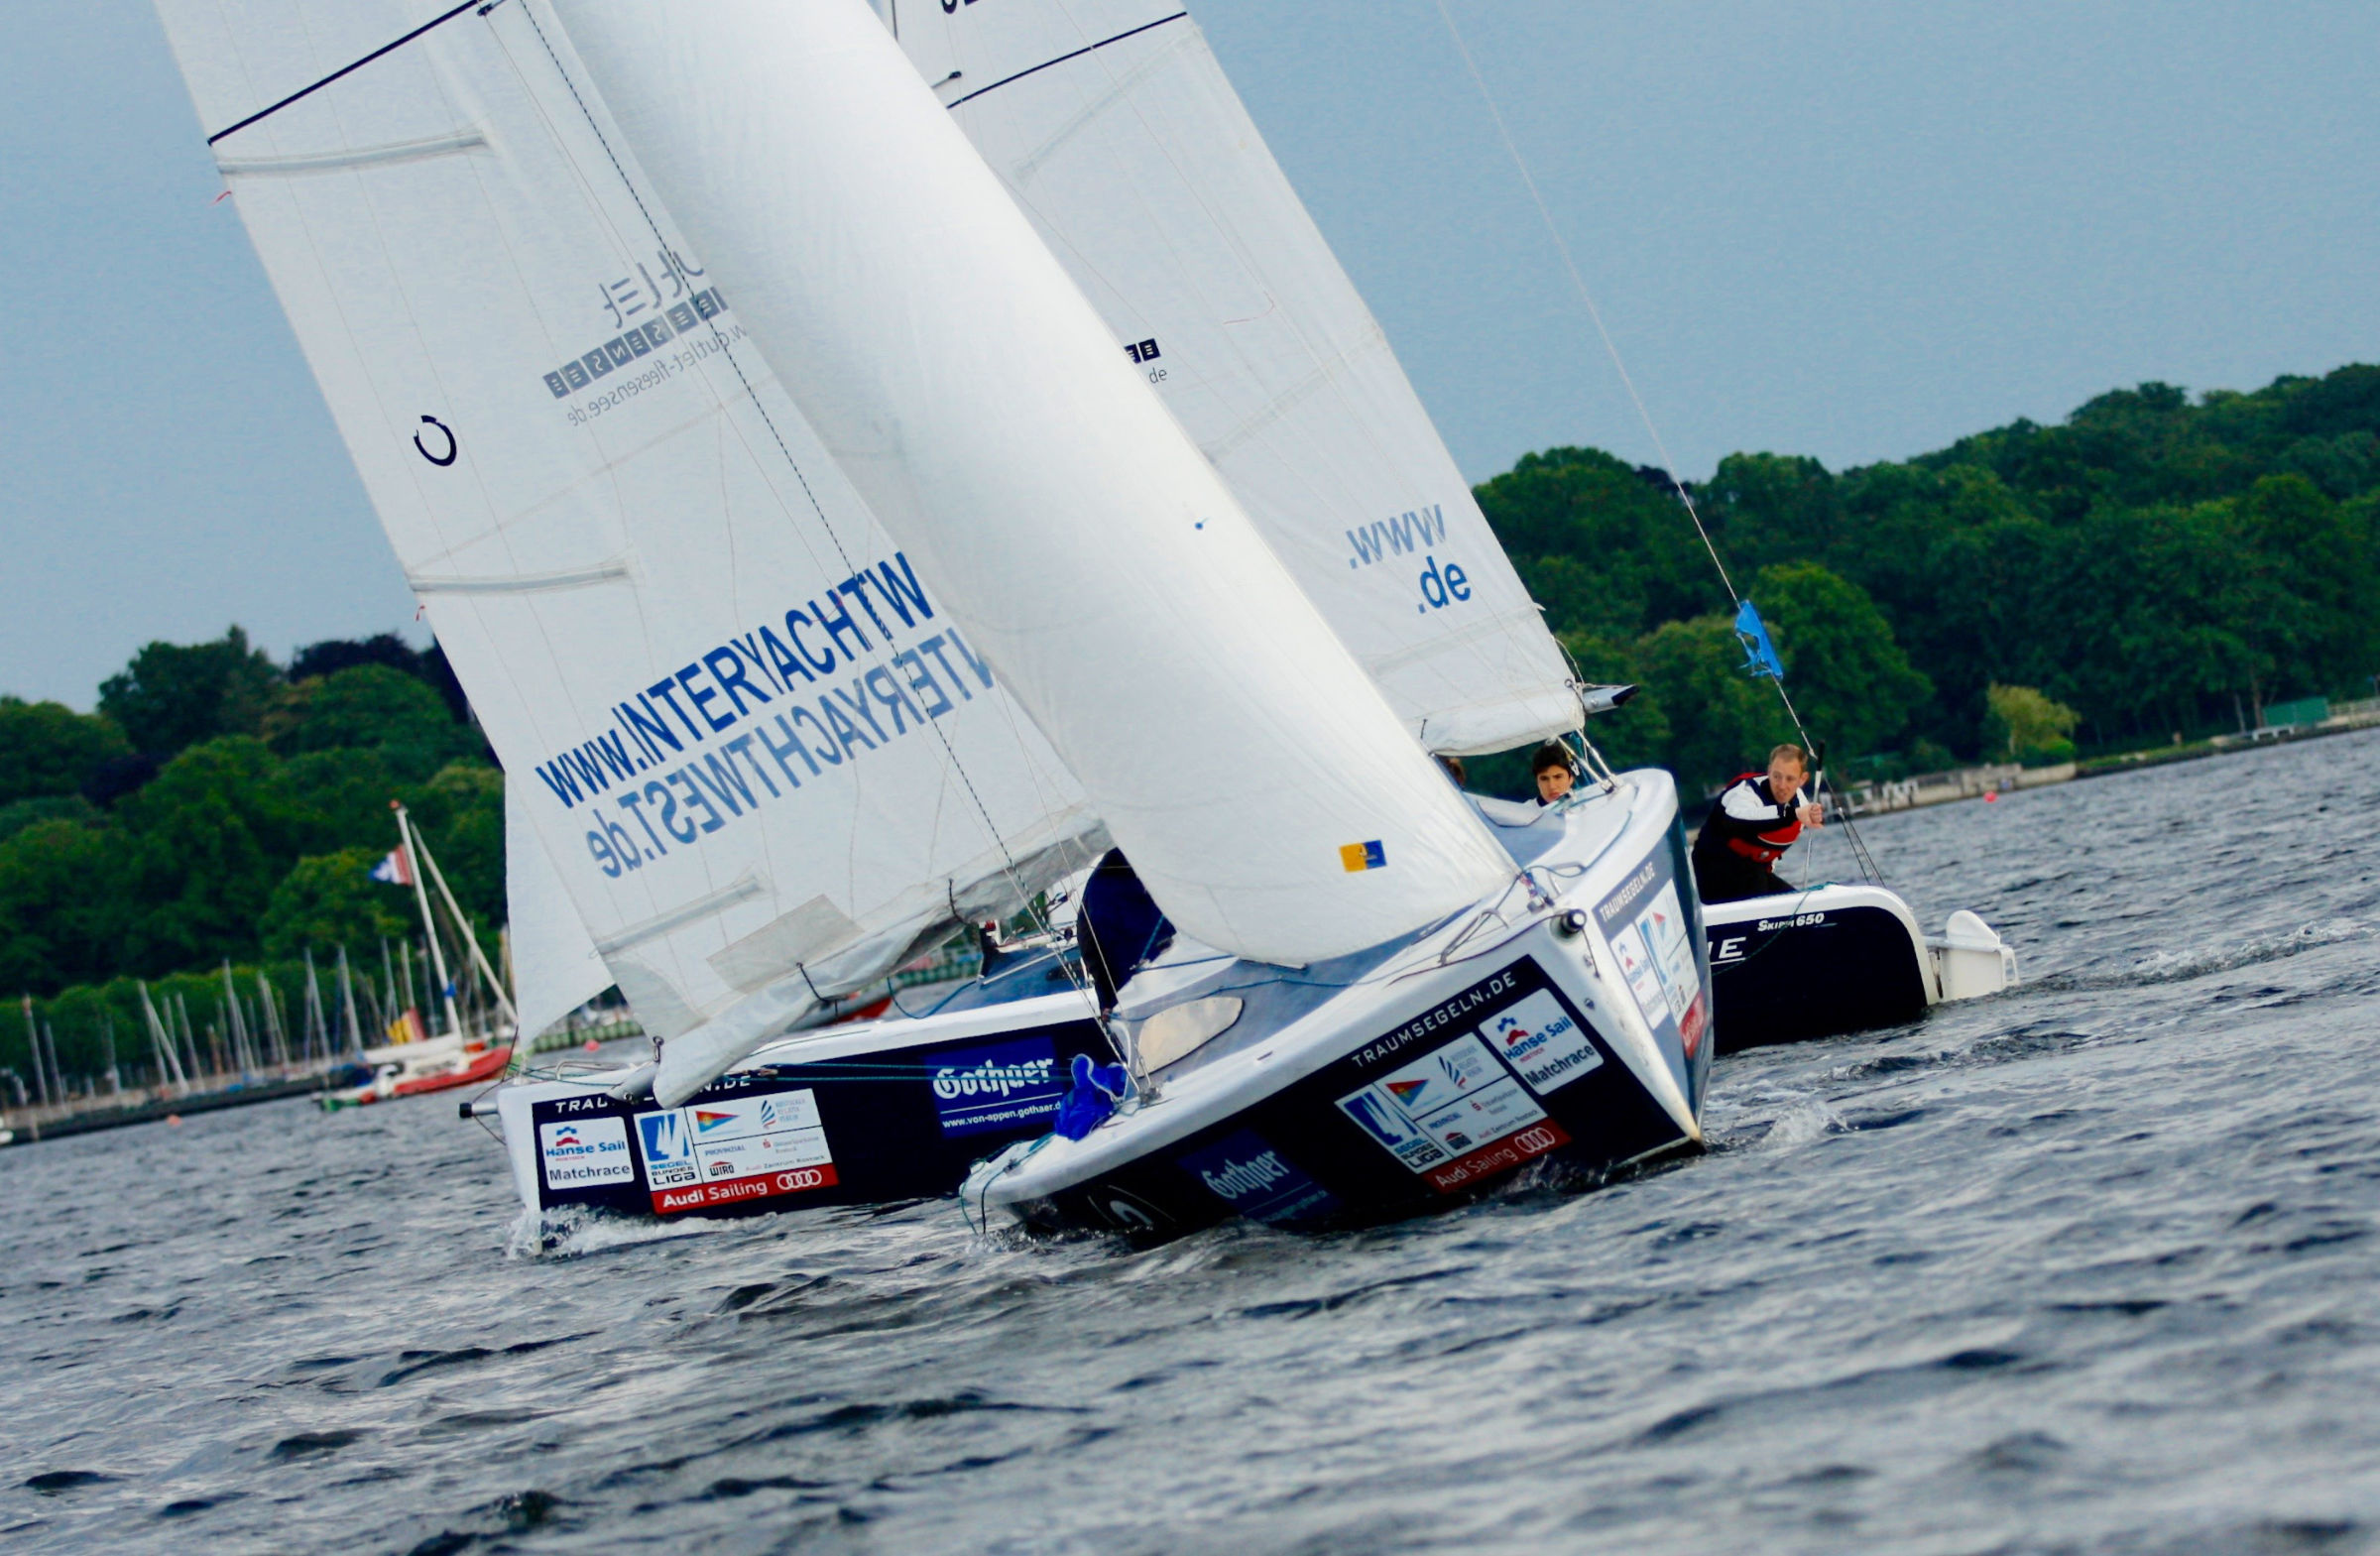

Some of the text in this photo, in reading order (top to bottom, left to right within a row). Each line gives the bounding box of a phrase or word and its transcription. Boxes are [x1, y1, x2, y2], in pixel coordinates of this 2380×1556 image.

[1418, 555, 1471, 614] .de
[1796, 912, 1825, 926] 650
[1352, 972, 1516, 1067] TRAUMSEGELN.DE
[1503, 1017, 1573, 1060] Hanse Sail
[933, 1058, 1053, 1099] Gothaer
[1525, 1044, 1595, 1086] Matchrace
[546, 1140, 626, 1157] Hanse Sail
[651, 1158, 692, 1170] SEGEL
[1435, 1147, 1518, 1187] Audi Sailing
[549, 1164, 631, 1181] Matchrace
[710, 1164, 735, 1176] WIRO
[1201, 1150, 1290, 1199] Gothaer
[663, 1181, 768, 1208] Audi Sailing
